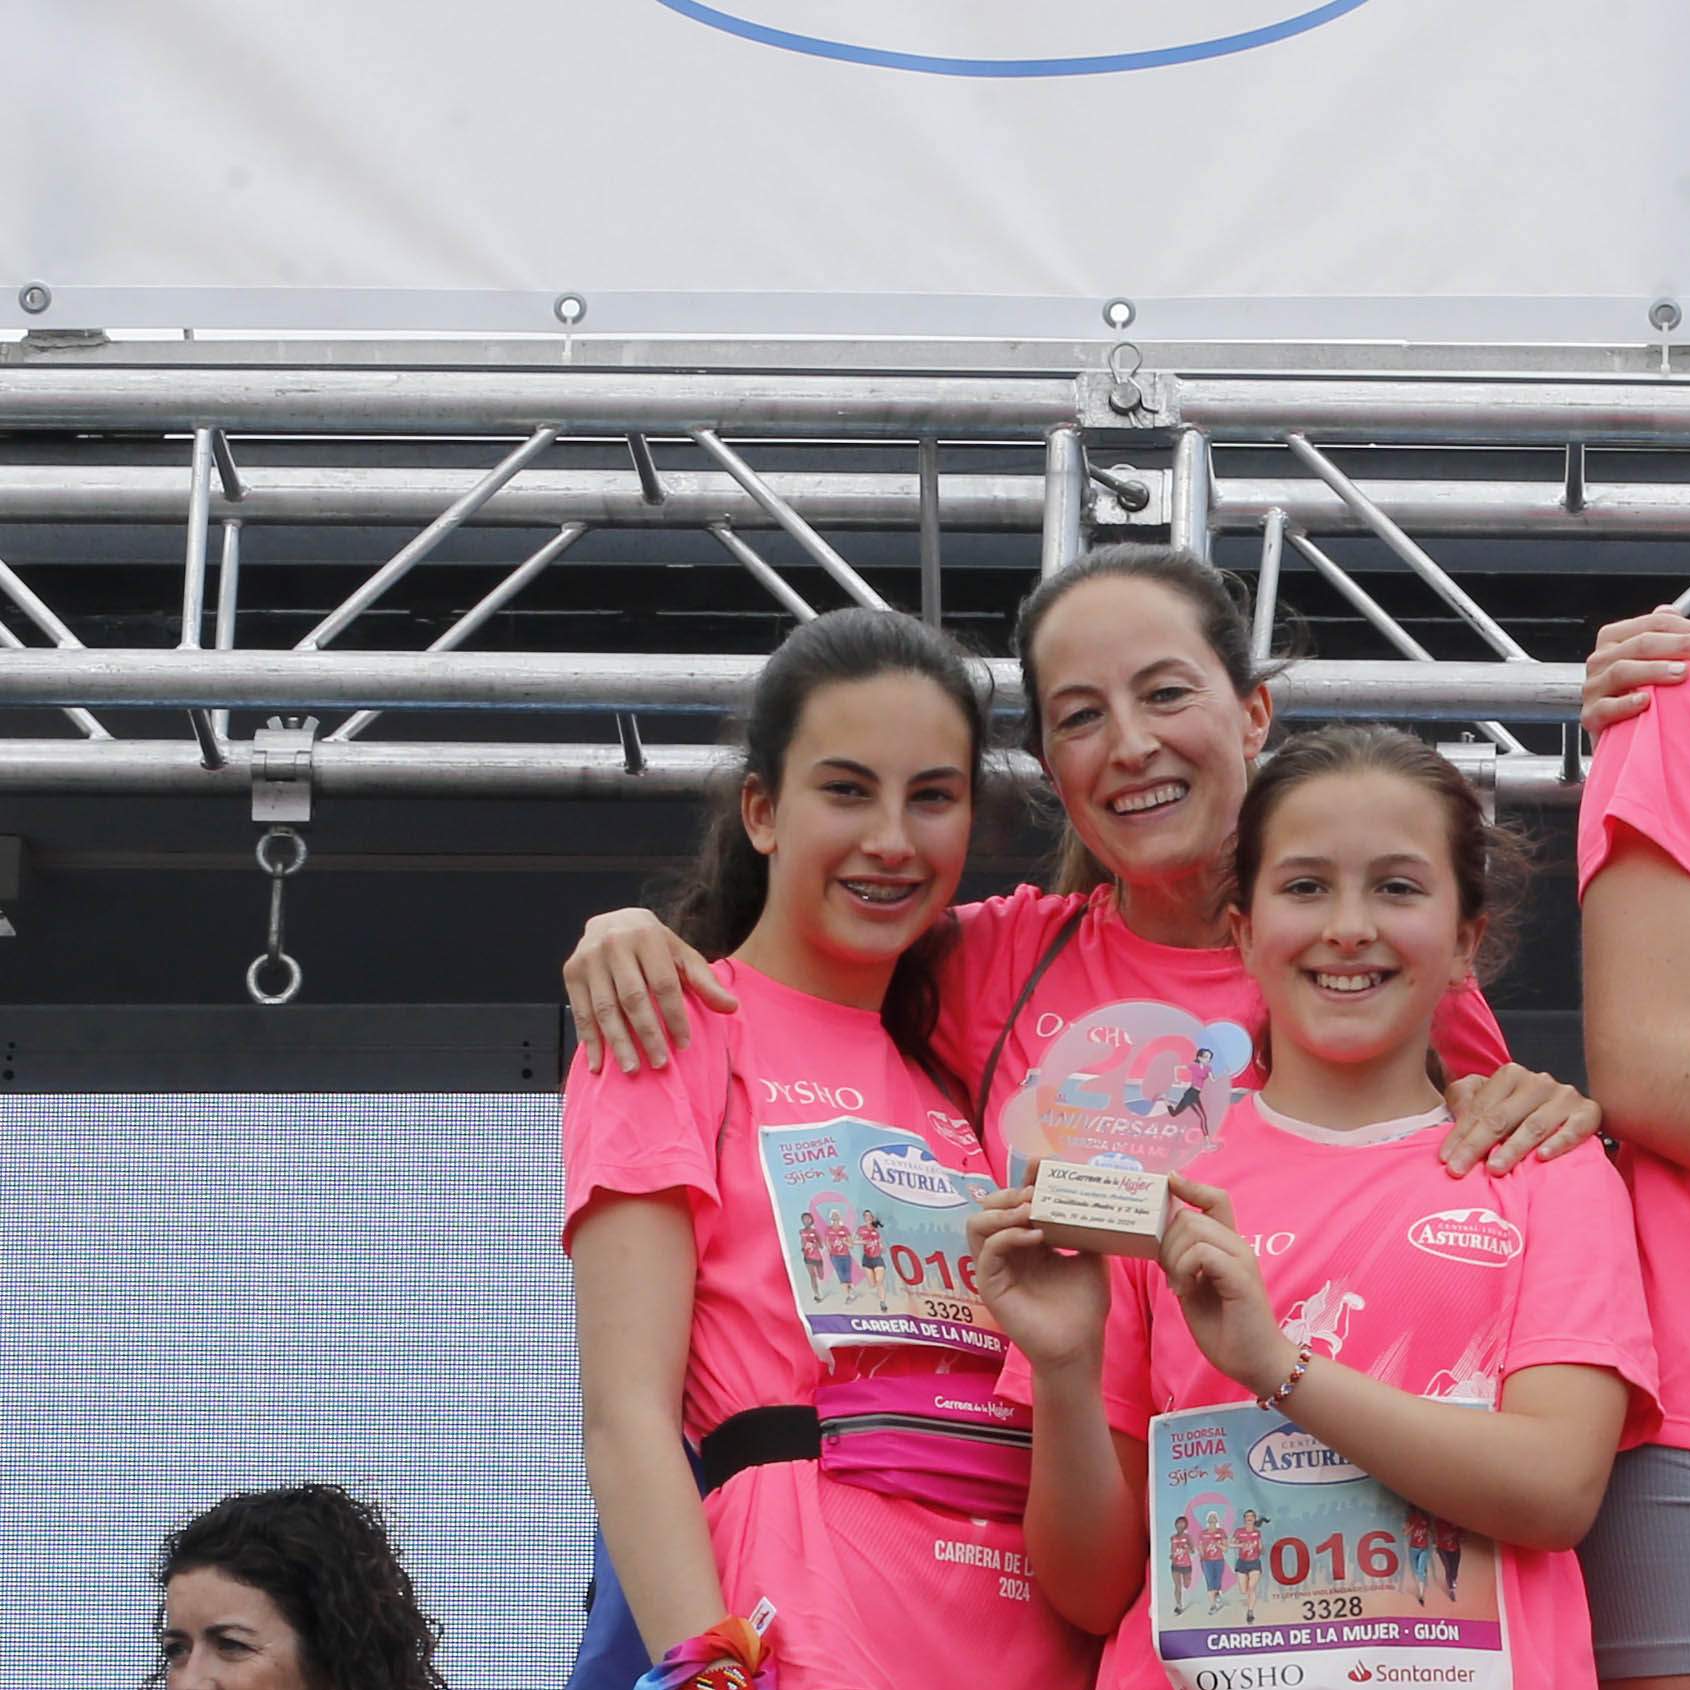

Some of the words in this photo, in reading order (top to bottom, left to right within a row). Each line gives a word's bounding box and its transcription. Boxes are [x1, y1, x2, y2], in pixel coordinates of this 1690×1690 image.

[780, 1142, 794, 1152] TU
[795, 1136, 836, 1150] DORSAL
[783, 1145, 839, 1166] SUMA
[871, 1158, 957, 1195] ASTURIA
[924, 1300, 974, 1323] 3329
[851, 1318, 919, 1335] CARRERA
[922, 1322, 941, 1338] DE
[942, 1327, 960, 1342] LA
[962, 1328, 1003, 1352] MUJER
[934, 1395, 974, 1413] Carrera
[1171, 1432, 1186, 1442] TU
[1187, 1427, 1227, 1440] DORSAL
[1172, 1439, 1227, 1460] SUMA
[934, 1540, 1001, 1571] CARRERA
[1004, 1551, 1021, 1574] DE
[1269, 1530, 1399, 1586] 016
[999, 1577, 1031, 1601] 2024
[1303, 1597, 1363, 1621] 3328
[1207, 1630, 1283, 1650] CARRERA
[1290, 1628, 1311, 1646] DE
[1317, 1626, 1338, 1643] LA
[1343, 1623, 1400, 1641] MUJER
[1415, 1619, 1460, 1641] GIJÓN
[1376, 1664, 1476, 1684] Santander
